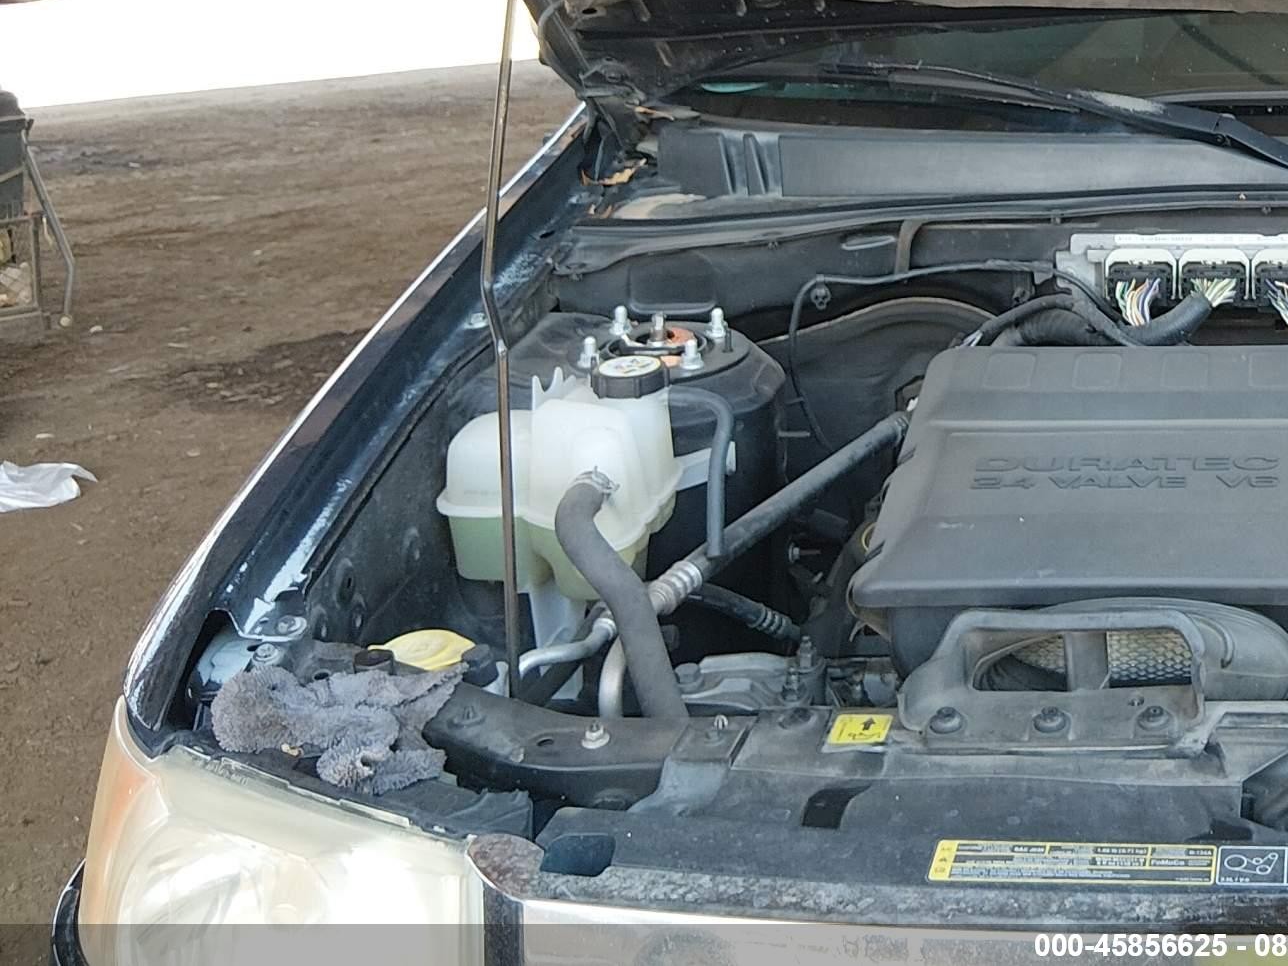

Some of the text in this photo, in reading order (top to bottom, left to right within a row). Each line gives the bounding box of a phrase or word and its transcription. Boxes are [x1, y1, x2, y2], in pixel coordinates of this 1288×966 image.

[975, 456, 1280, 472] DURATEC
[970, 475, 1280, 489] 24 VALVE V6
